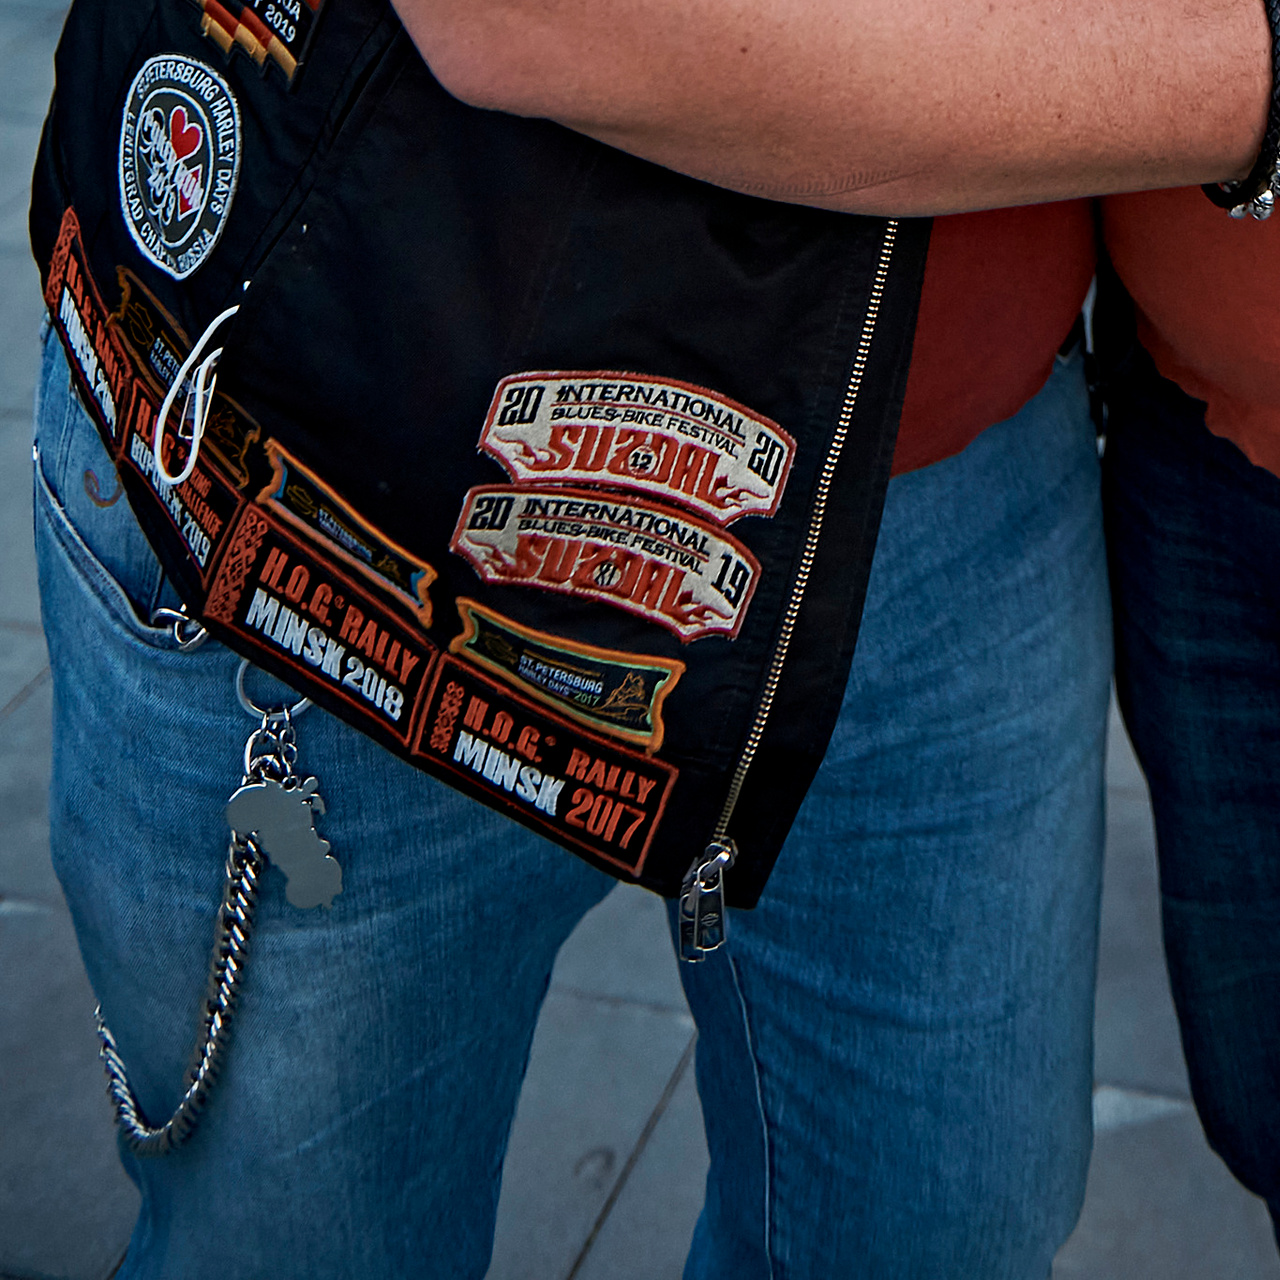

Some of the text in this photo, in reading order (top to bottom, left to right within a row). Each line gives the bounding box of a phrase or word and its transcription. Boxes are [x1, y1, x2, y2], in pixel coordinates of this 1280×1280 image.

[264, 3, 297, 43] 2019
[210, 96, 236, 163] HARLEY
[211, 169, 232, 215] DAYS
[497, 385, 786, 487] 20 INTERNATIONAL 20
[550, 405, 739, 460] BLUES-BIKE FESTIVAL
[181, 510, 211, 568] 2019
[469, 496, 751, 610] 20 INTERNATIONAL 19
[518, 519, 703, 576] BLUES-BIKE FESTIVAL
[245, 587, 405, 722] MINSK 2018
[338, 604, 420, 686] RALLY
[535, 662, 604, 694] PETERSBURG
[574, 690, 601, 707] 2017
[453, 729, 646, 850] MINSK 2017
[564, 746, 657, 805] RALLY
